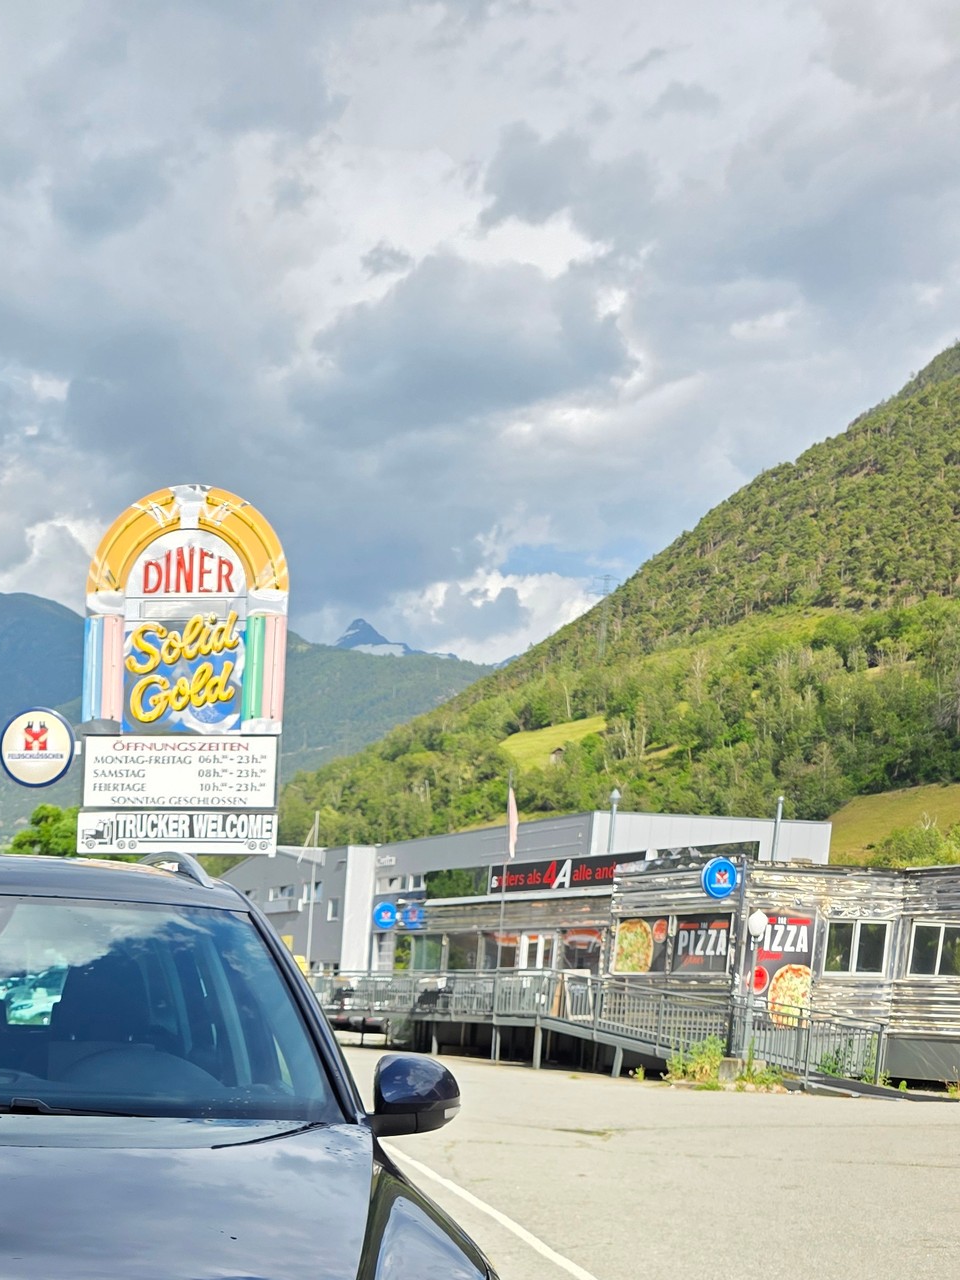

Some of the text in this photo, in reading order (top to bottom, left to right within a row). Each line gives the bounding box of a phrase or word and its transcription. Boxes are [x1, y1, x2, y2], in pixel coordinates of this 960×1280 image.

[143, 545, 235, 594] DINER
[125, 610, 239, 675] Solid
[130, 661, 236, 723] Gold
[112, 739, 249, 752] ÖFFNUNGSZEITEN
[93, 755, 192, 765] MONTAG-FREITAG
[92, 769, 146, 778] SAMSTAG
[92, 782, 147, 792] FEIERTAGE
[110, 796, 247, 805] SONNTAG GESCHLOSSEN
[116, 814, 273, 839] TRUCKER WELCOME
[572, 864, 593, 881] alle
[677, 929, 727, 956] PIZZA
